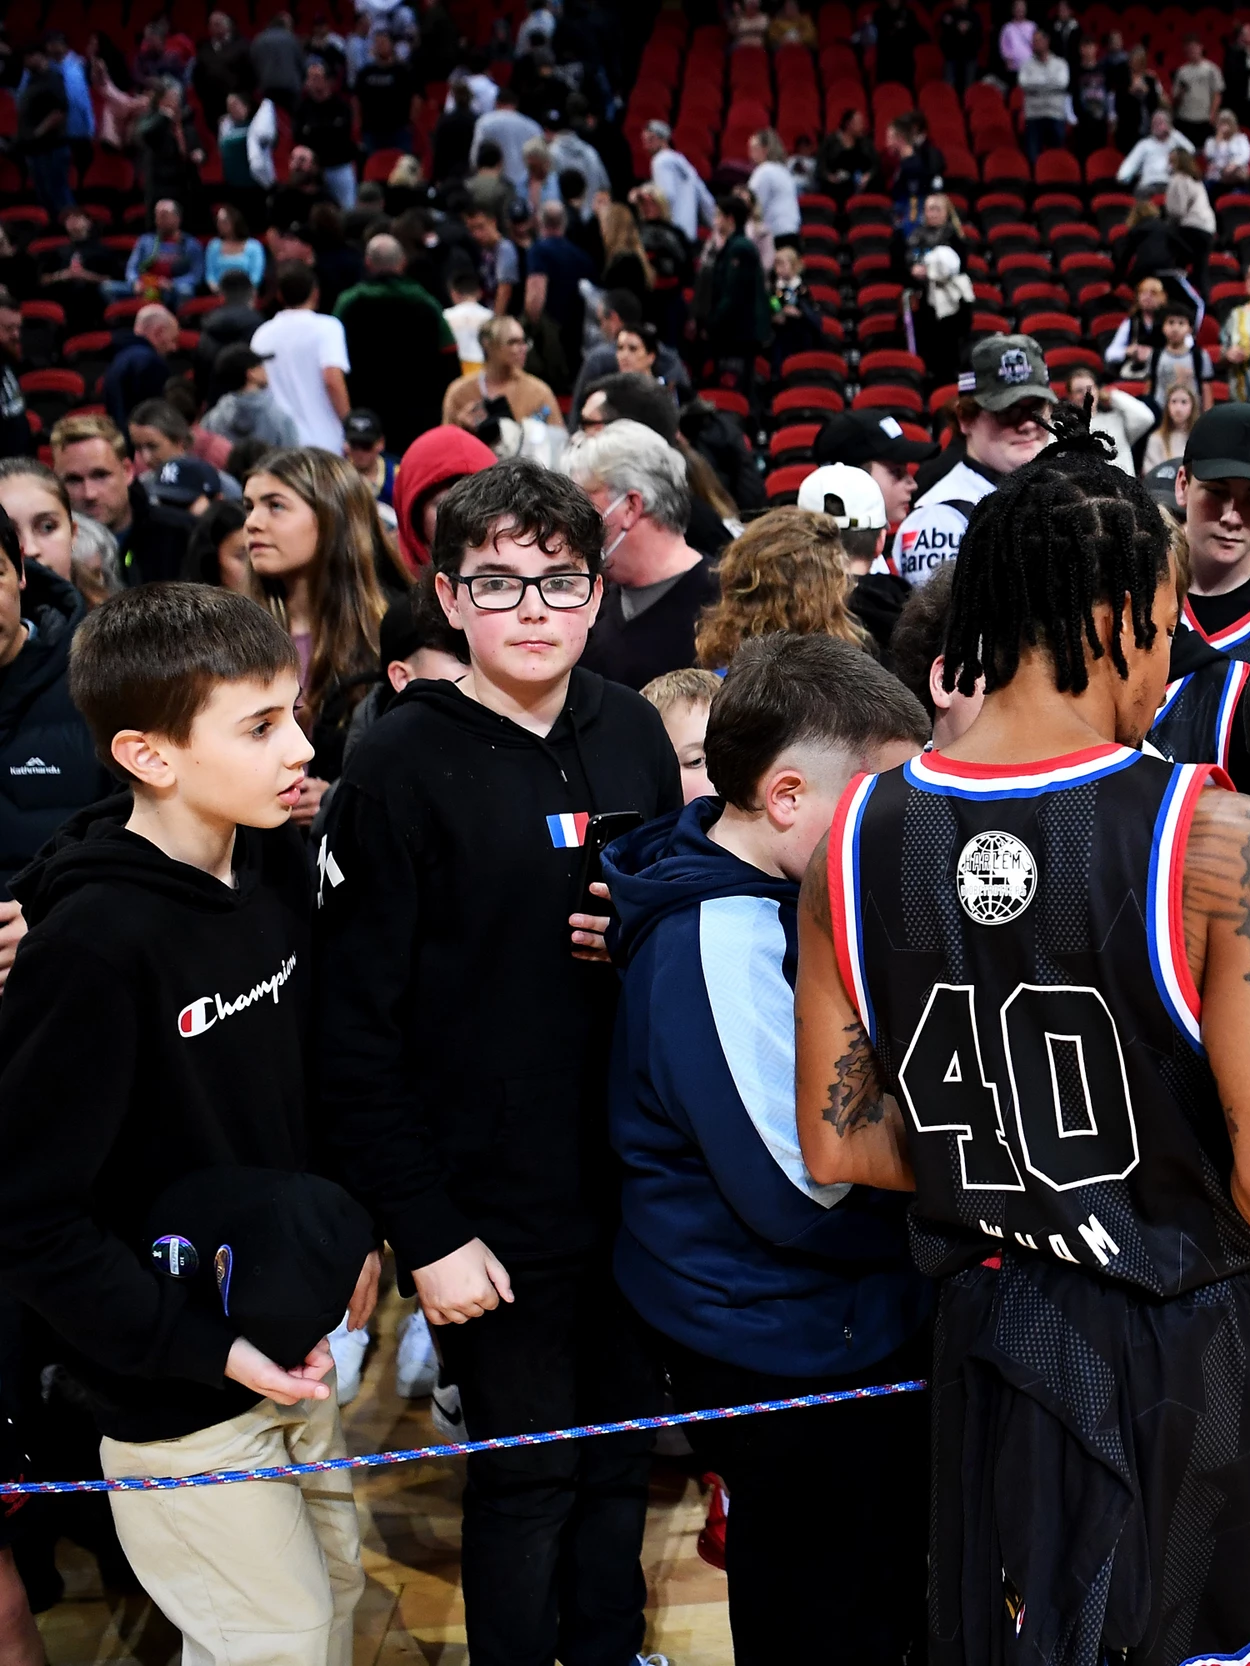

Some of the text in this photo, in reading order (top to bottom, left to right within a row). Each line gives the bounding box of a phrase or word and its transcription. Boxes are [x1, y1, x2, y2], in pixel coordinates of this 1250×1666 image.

[964, 851, 1022, 870] HARLEM
[178, 950, 297, 1038] Champion
[898, 982, 1140, 1192] 40
